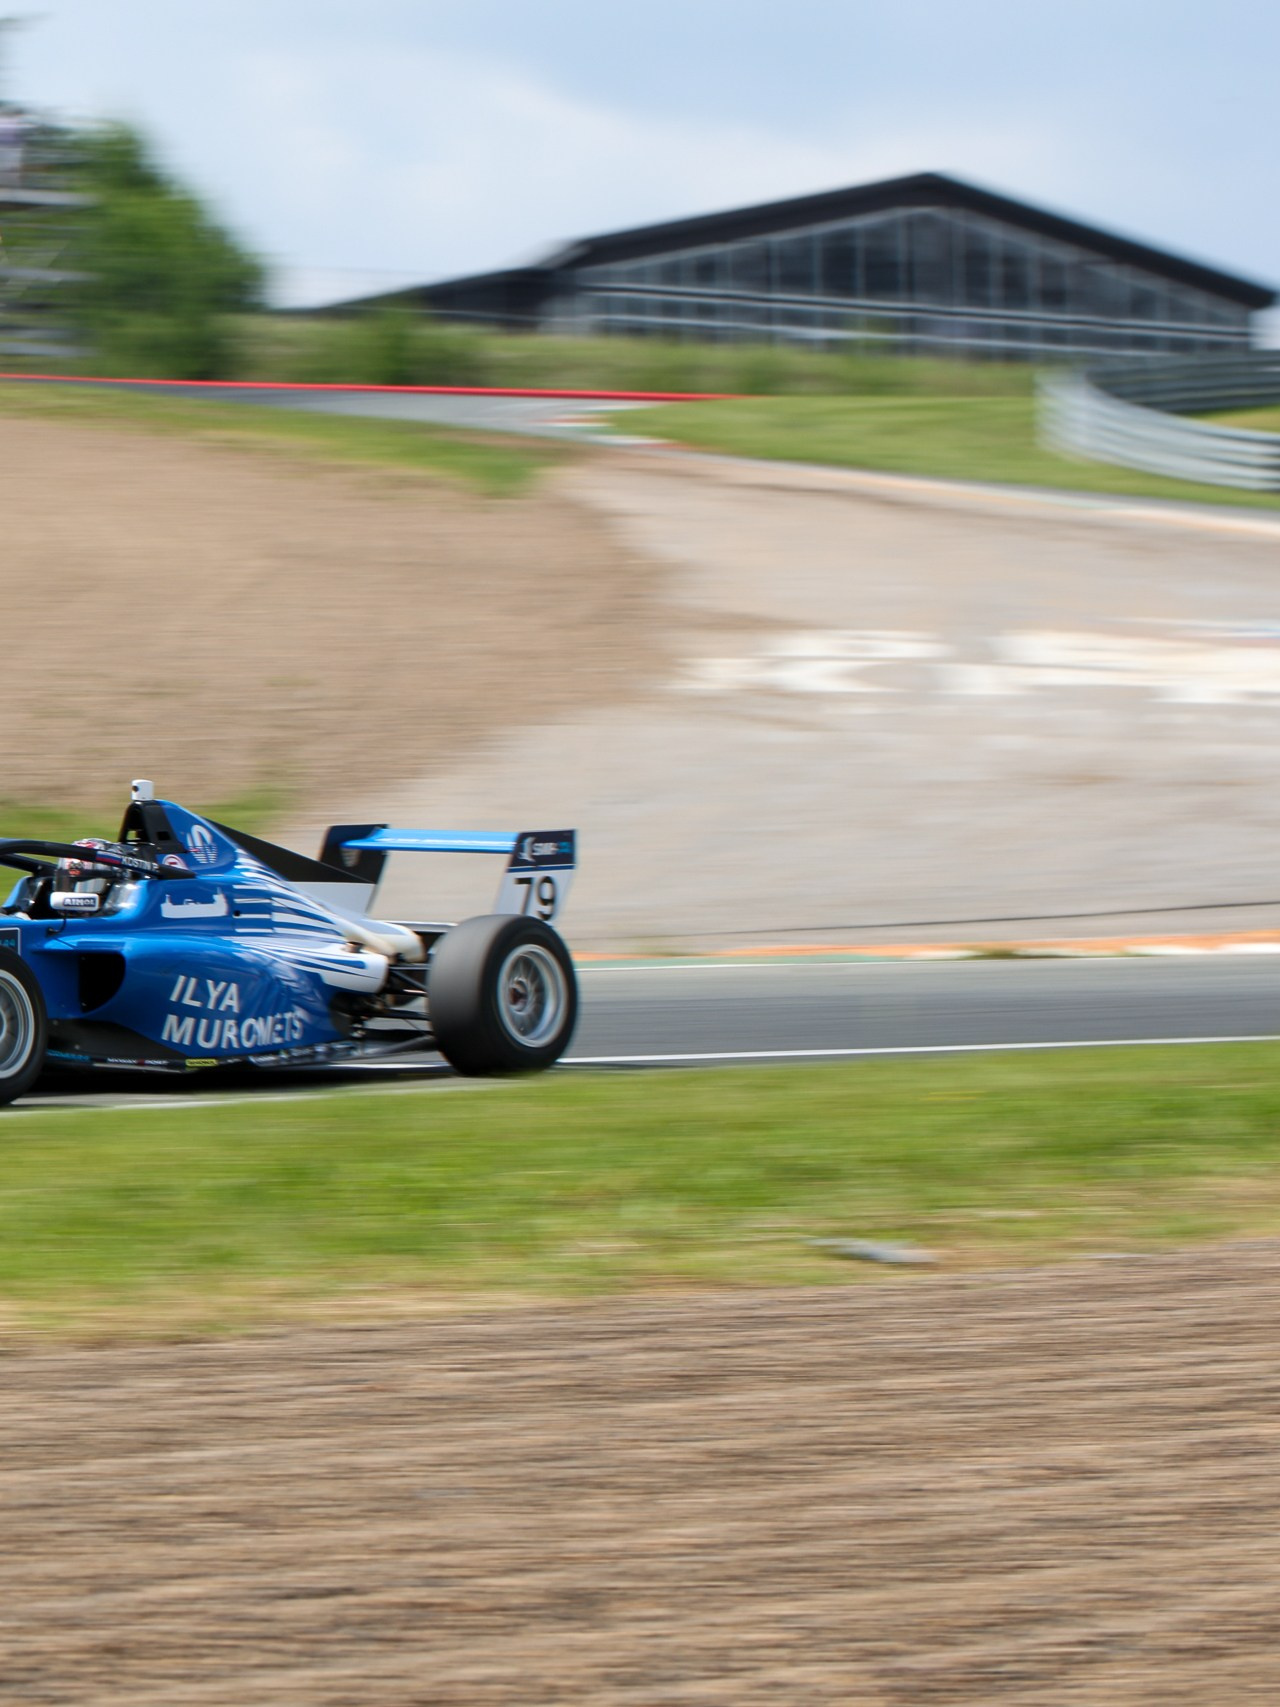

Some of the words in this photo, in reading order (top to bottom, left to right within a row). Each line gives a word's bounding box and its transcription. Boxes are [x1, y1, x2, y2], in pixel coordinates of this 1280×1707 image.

[513, 876, 556, 921] 79
[170, 975, 240, 1013] ILYA
[161, 1012, 304, 1049] MUROMETS
